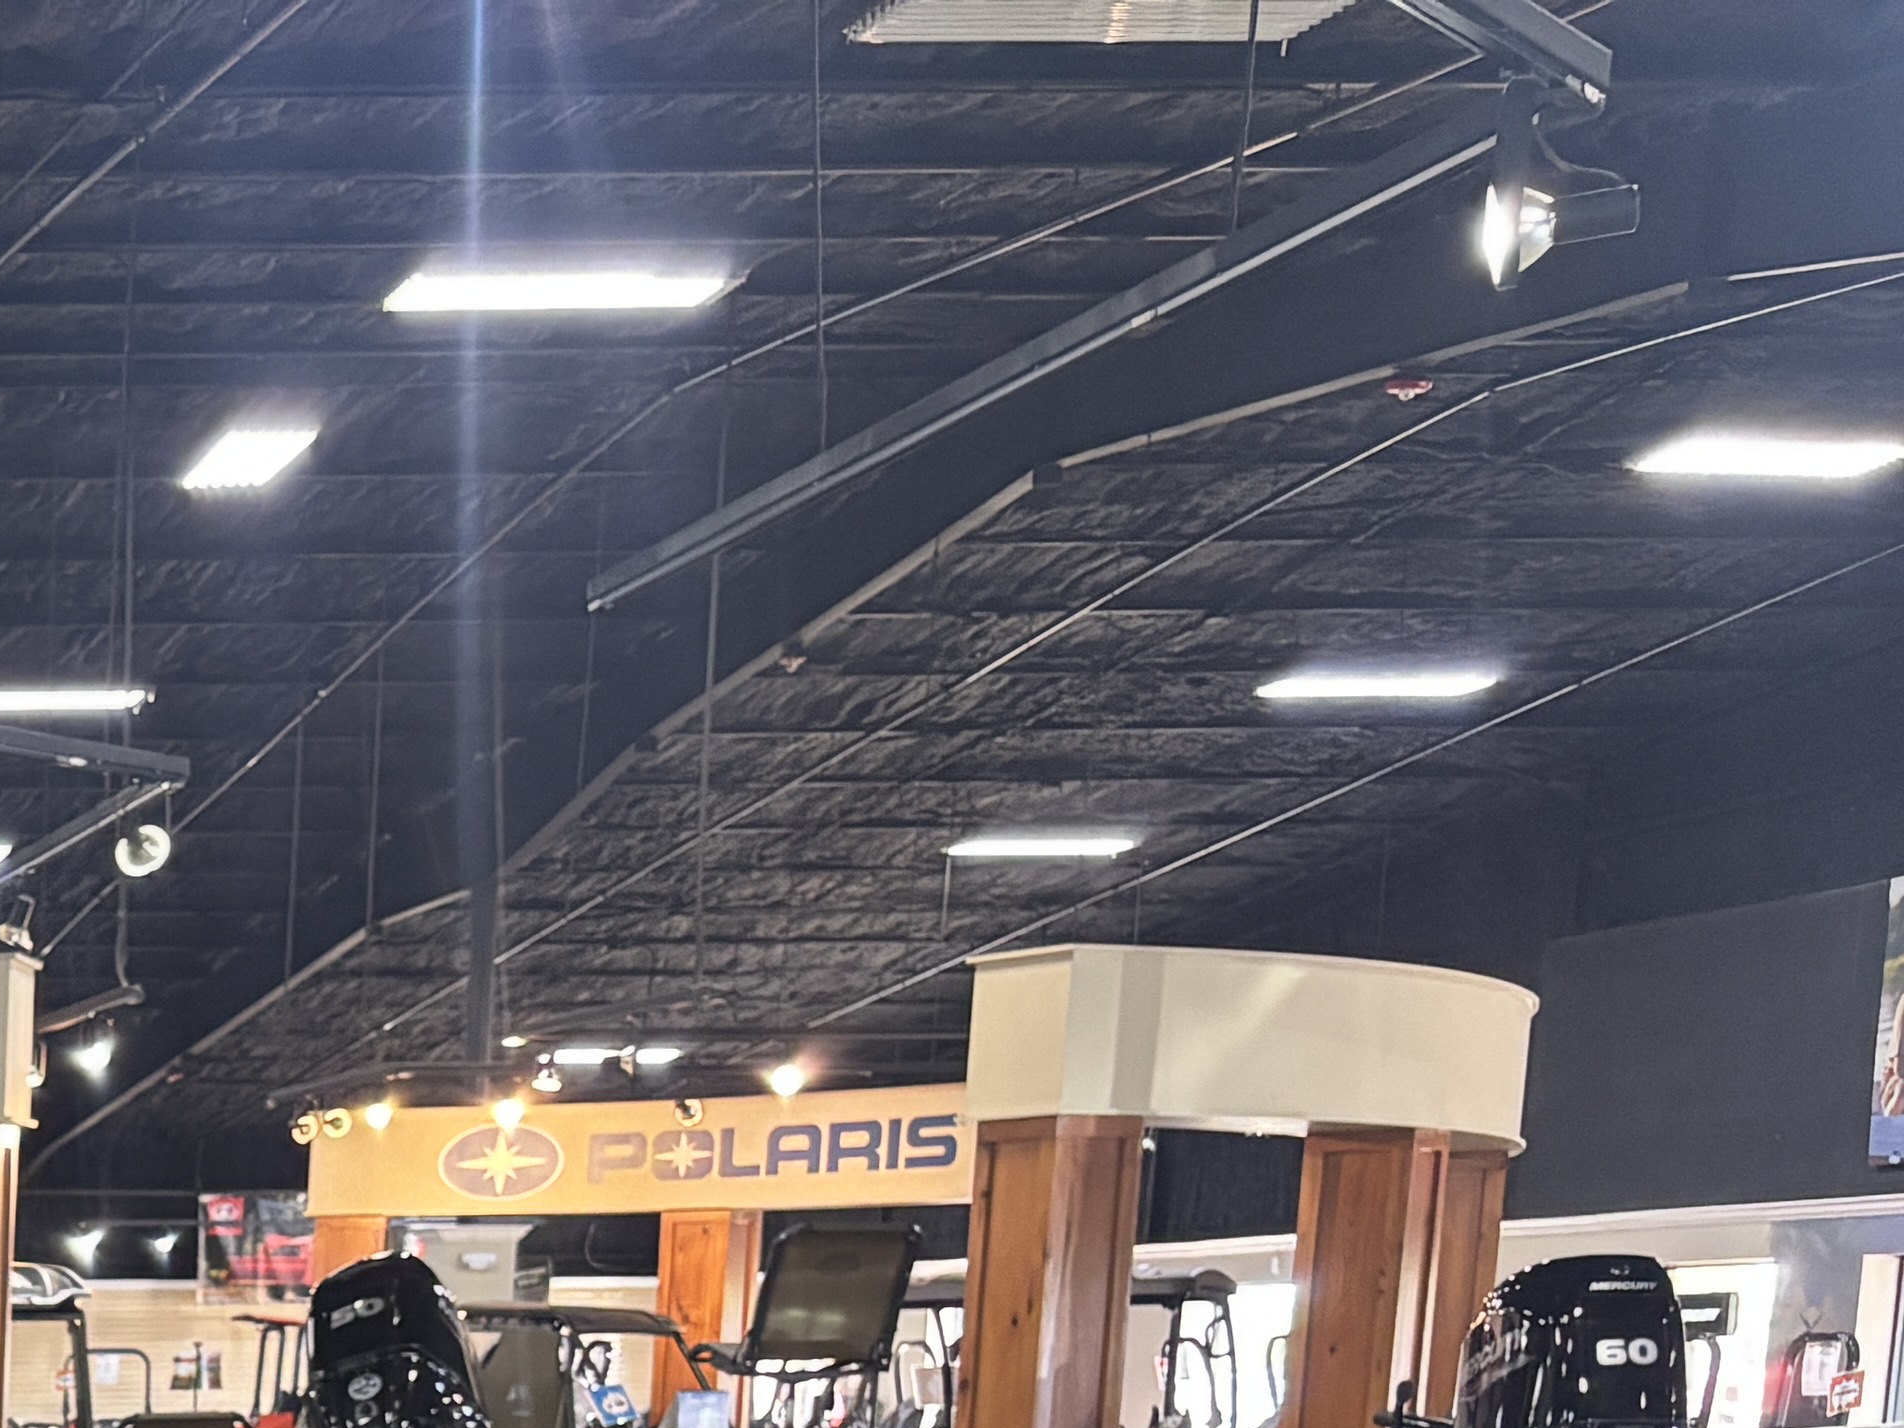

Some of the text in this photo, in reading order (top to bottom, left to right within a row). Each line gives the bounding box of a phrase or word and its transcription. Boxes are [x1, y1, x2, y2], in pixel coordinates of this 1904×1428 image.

[587, 1112, 959, 1185] POLARIS
[1588, 1280, 1658, 1292] MERCURY
[1595, 1338, 1659, 1366] 60
